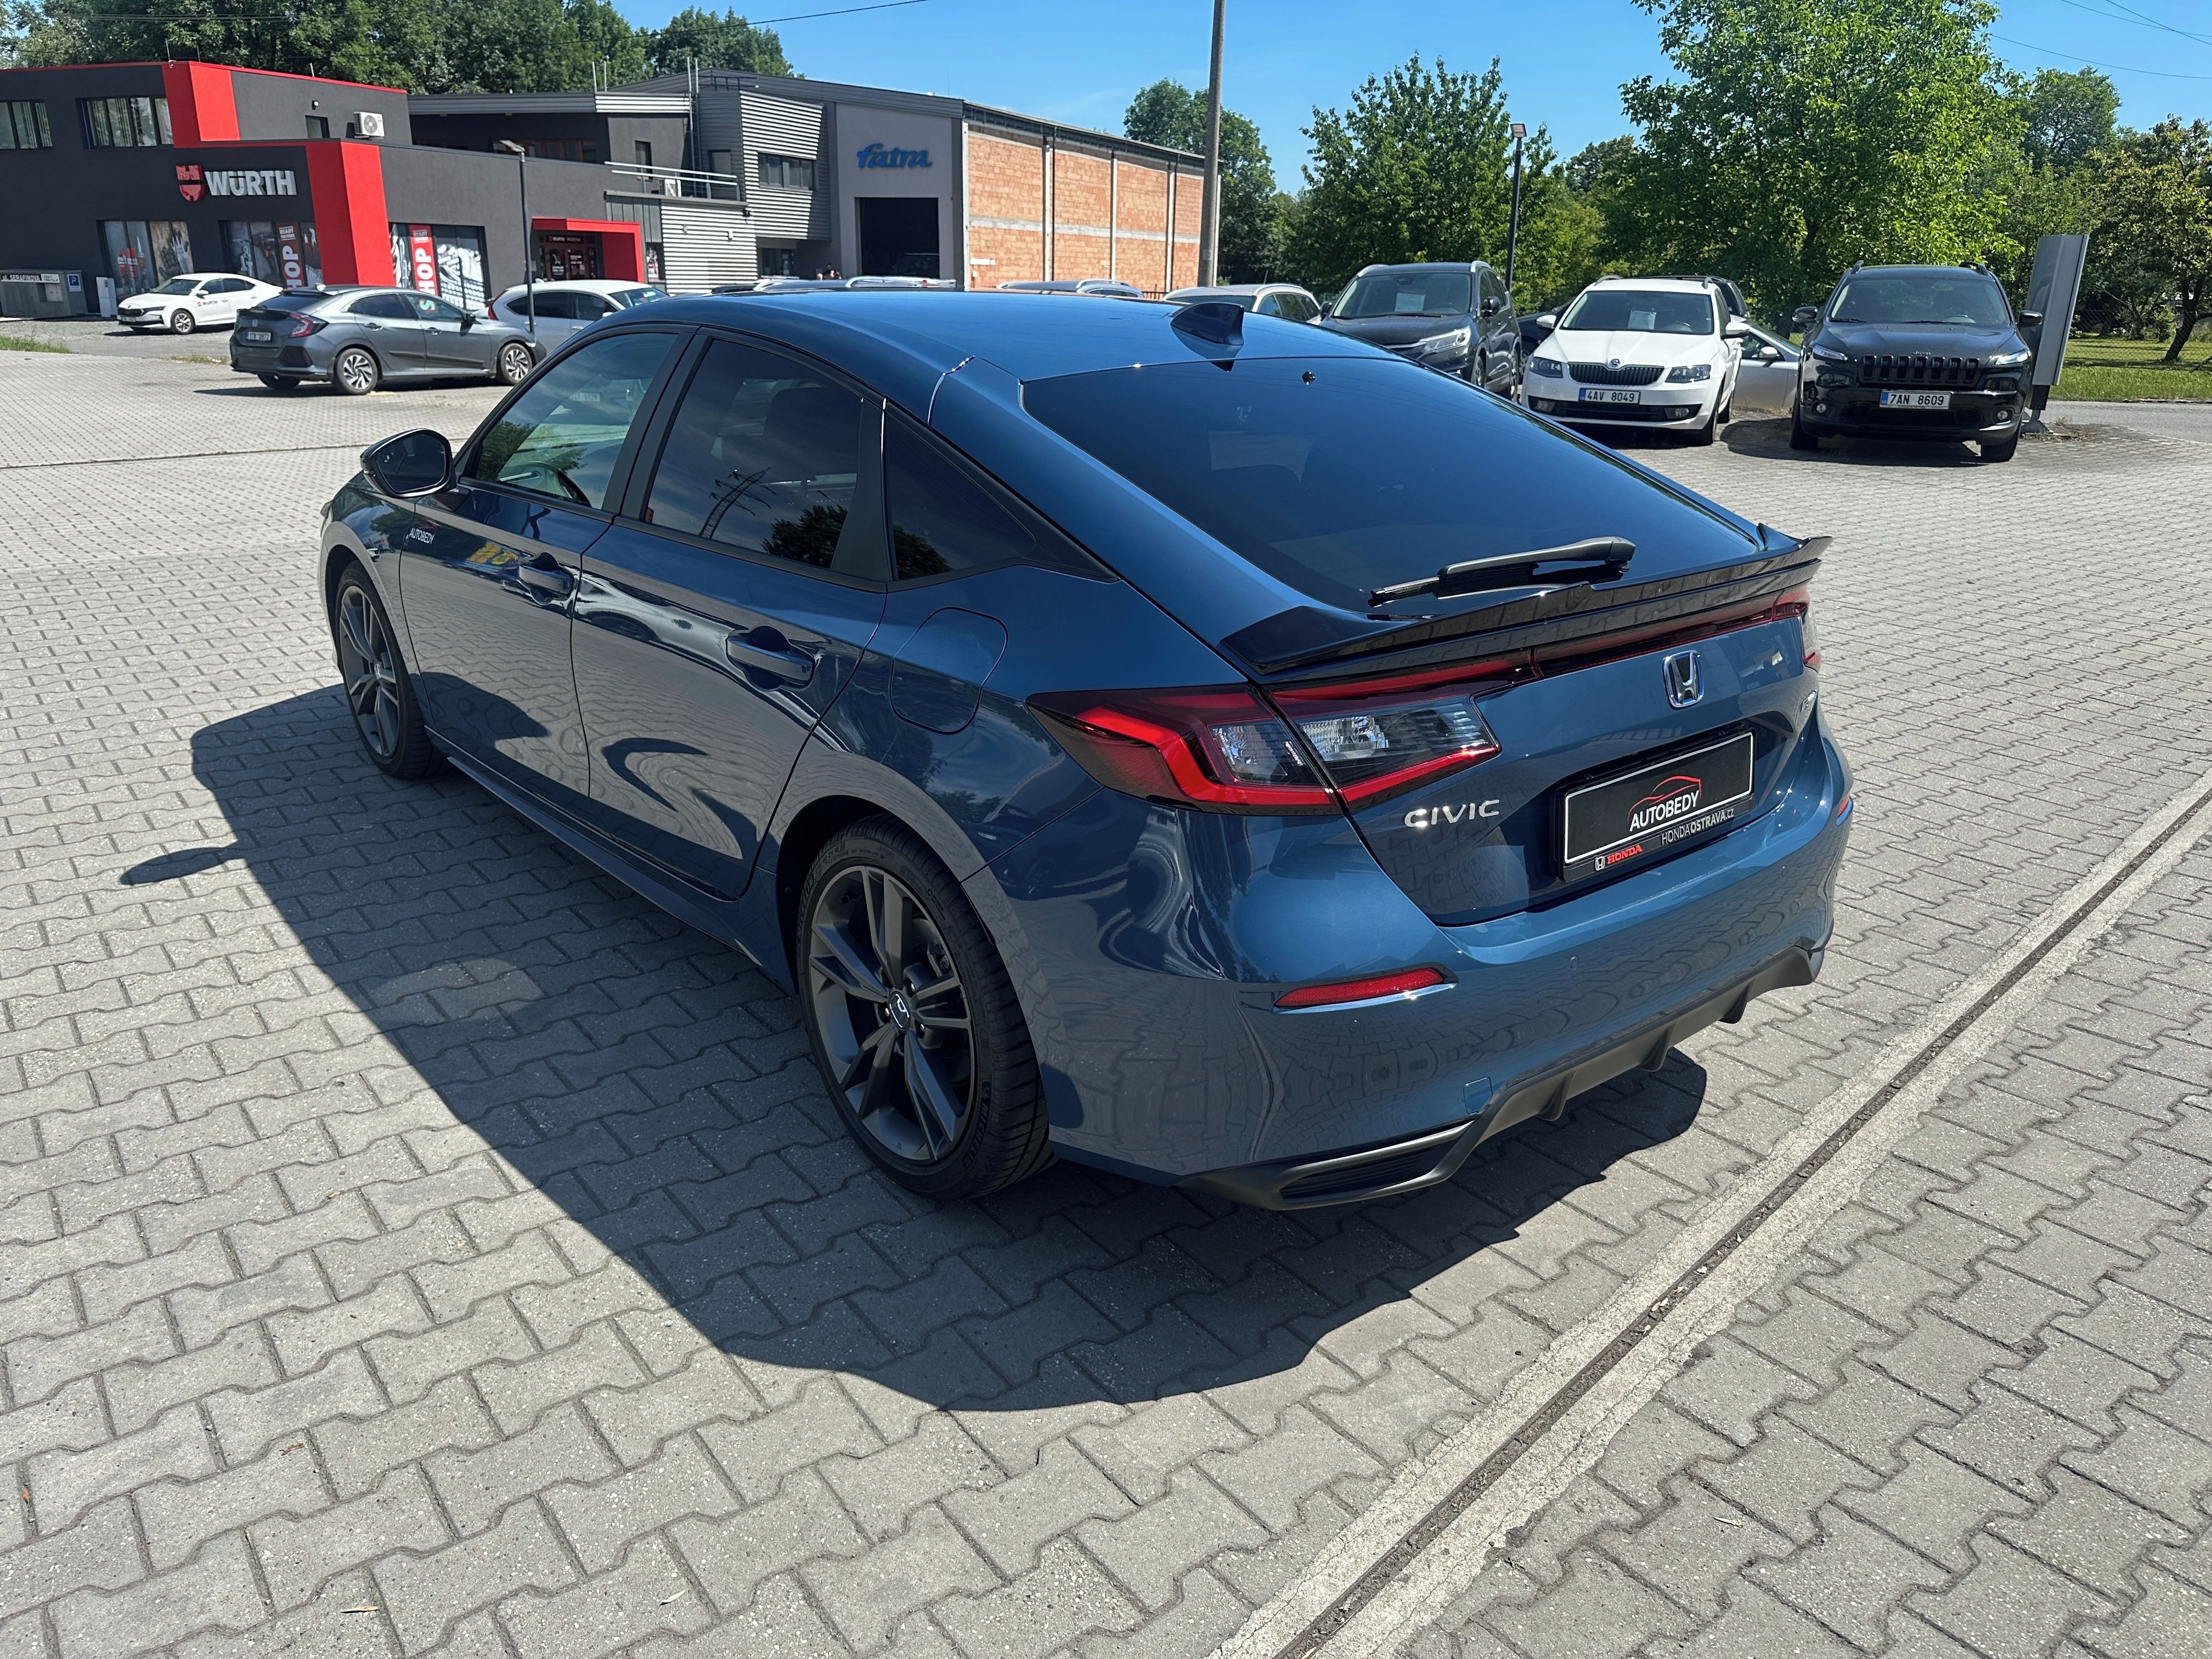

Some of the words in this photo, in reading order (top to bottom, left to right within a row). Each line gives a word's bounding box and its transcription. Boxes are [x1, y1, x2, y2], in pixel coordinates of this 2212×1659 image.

[205, 170, 297, 196] WÜRTH
[1587, 391, 1605, 400] 4AV
[1611, 392, 1635, 402] 8049
[1889, 394, 1910, 404] 7AN
[1917, 395, 1944, 405] 8609
[409, 527, 435, 545] AUTOBEDY
[1404, 799, 1499, 828] CIVIC
[1629, 789, 1700, 832] AUTOBEDY
[1606, 844, 1643, 865] HONDA
[961, 1102, 989, 1171] MICHELIN
